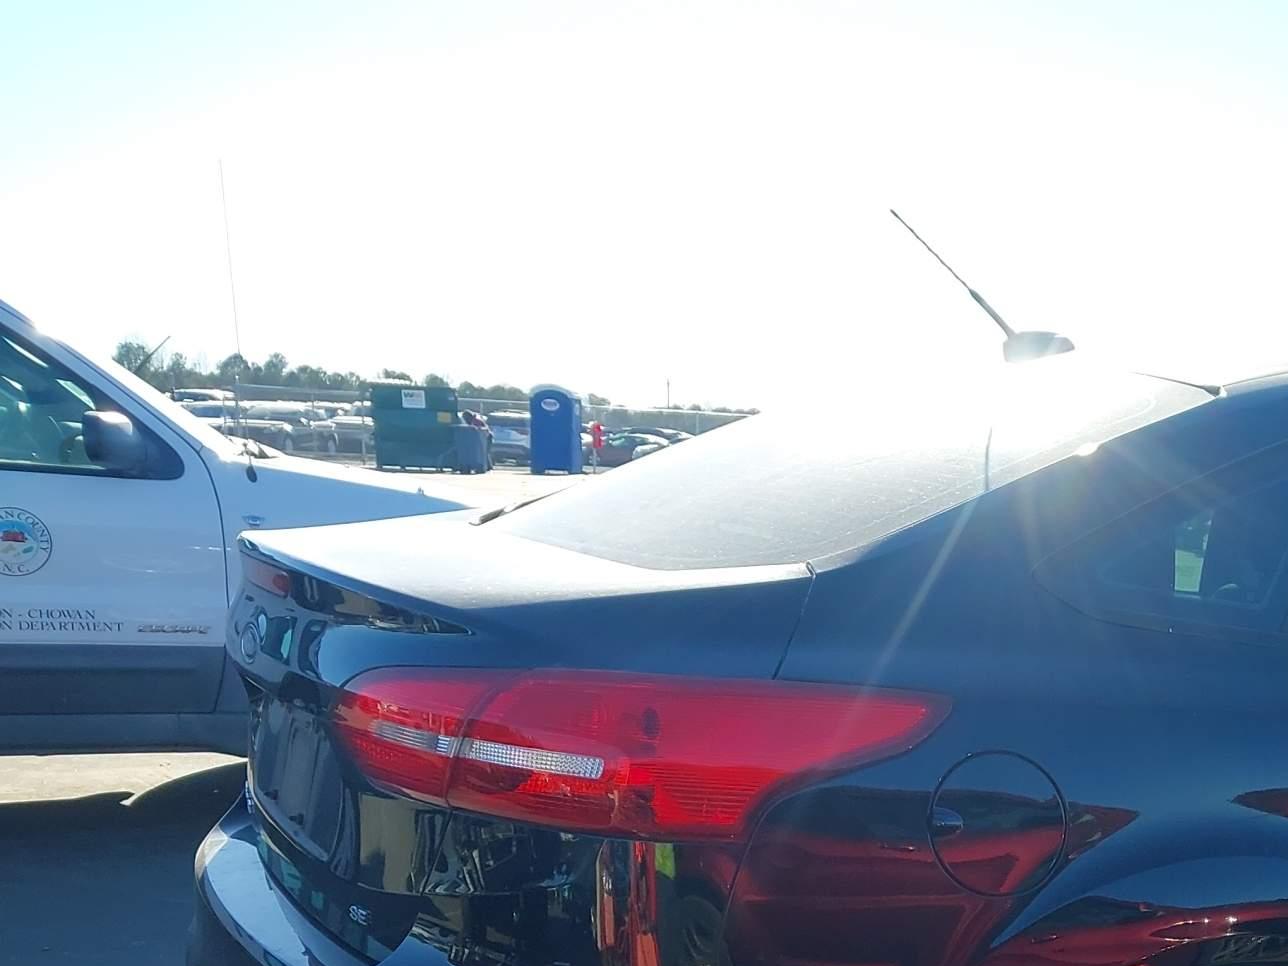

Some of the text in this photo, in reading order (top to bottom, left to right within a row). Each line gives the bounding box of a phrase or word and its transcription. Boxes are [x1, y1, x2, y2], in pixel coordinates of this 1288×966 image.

[17, 511, 49, 553] COUNTY
[27, 608, 96, 620] CHOWAN
[18, 619, 124, 632] DEPARTMENT
[348, 905, 370, 926] SE
